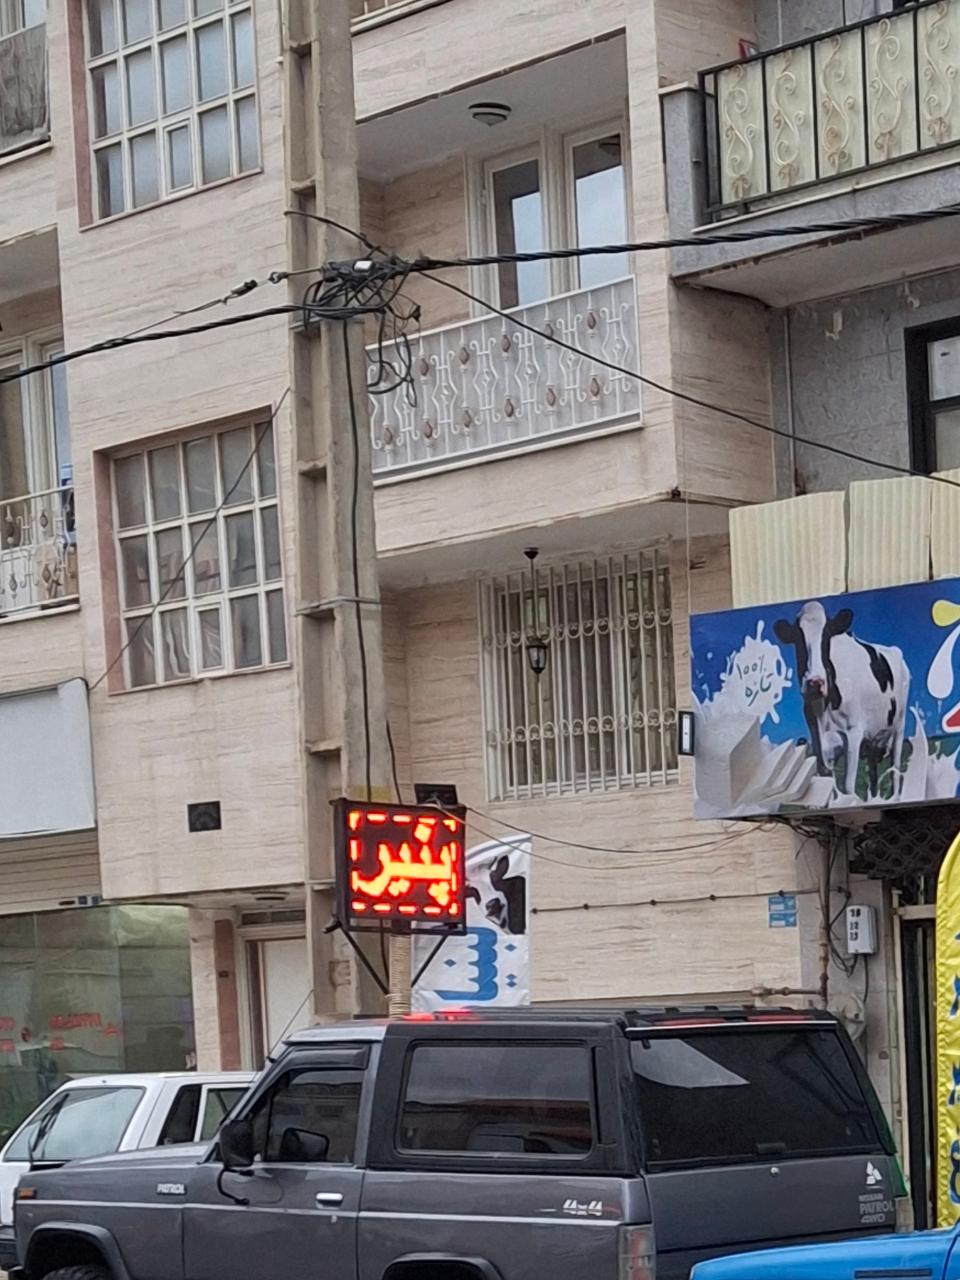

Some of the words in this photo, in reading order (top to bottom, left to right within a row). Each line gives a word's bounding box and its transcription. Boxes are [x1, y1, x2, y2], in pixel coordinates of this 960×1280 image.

[744, 671, 775, 708] تازه
[353, 822, 453, 907] پنیر
[860, 1200, 895, 1215] PATROL
